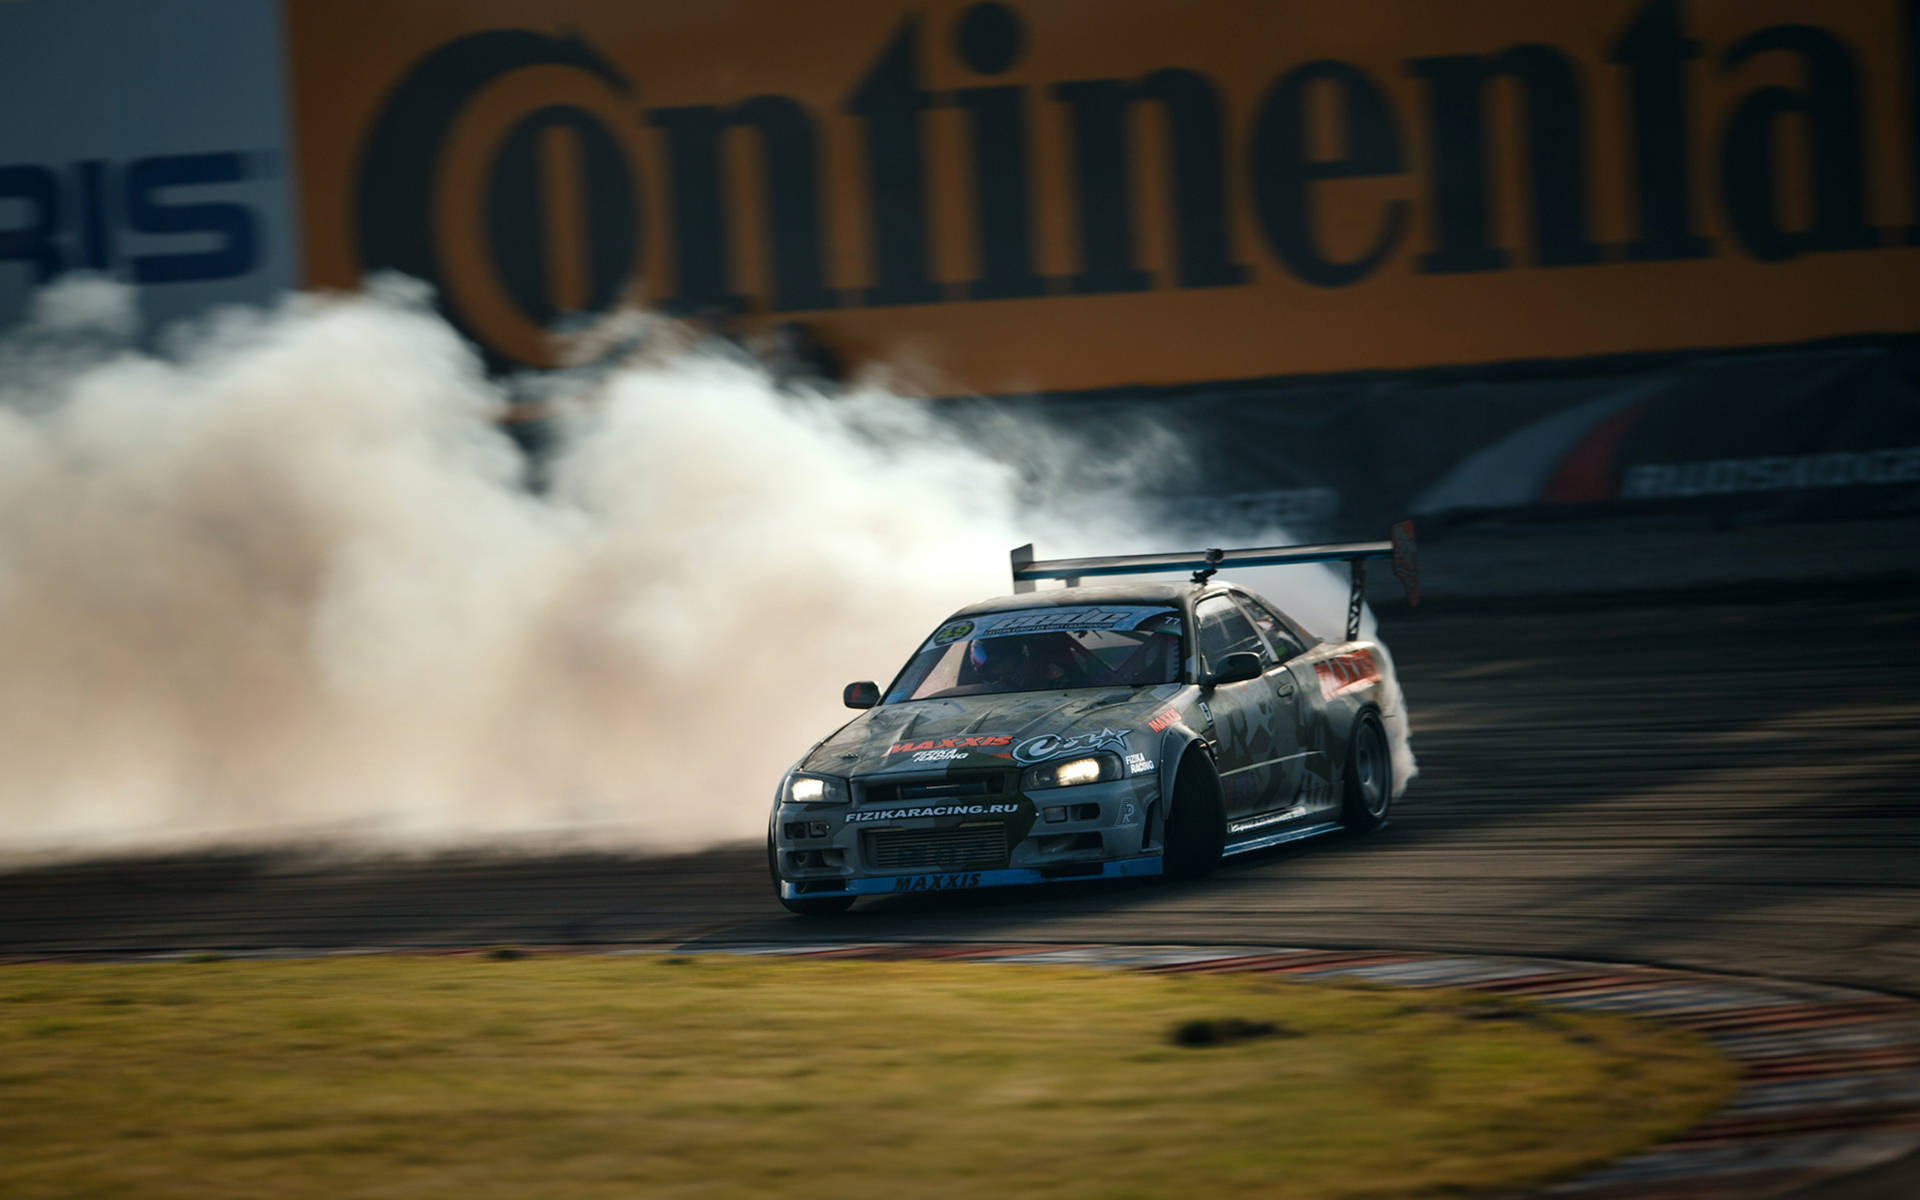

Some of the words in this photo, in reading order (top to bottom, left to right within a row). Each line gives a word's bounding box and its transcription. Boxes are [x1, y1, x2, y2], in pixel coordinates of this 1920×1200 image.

[353, 0, 1920, 368] Continenta
[882, 736, 1013, 757] MAXXIS
[913, 753, 969, 763] RACING
[1125, 752, 1145, 765] FIZIKA
[1131, 760, 1154, 774] RACING
[845, 804, 1018, 823] FIZIKARACING.RU
[893, 873, 981, 891] MAXXIS
